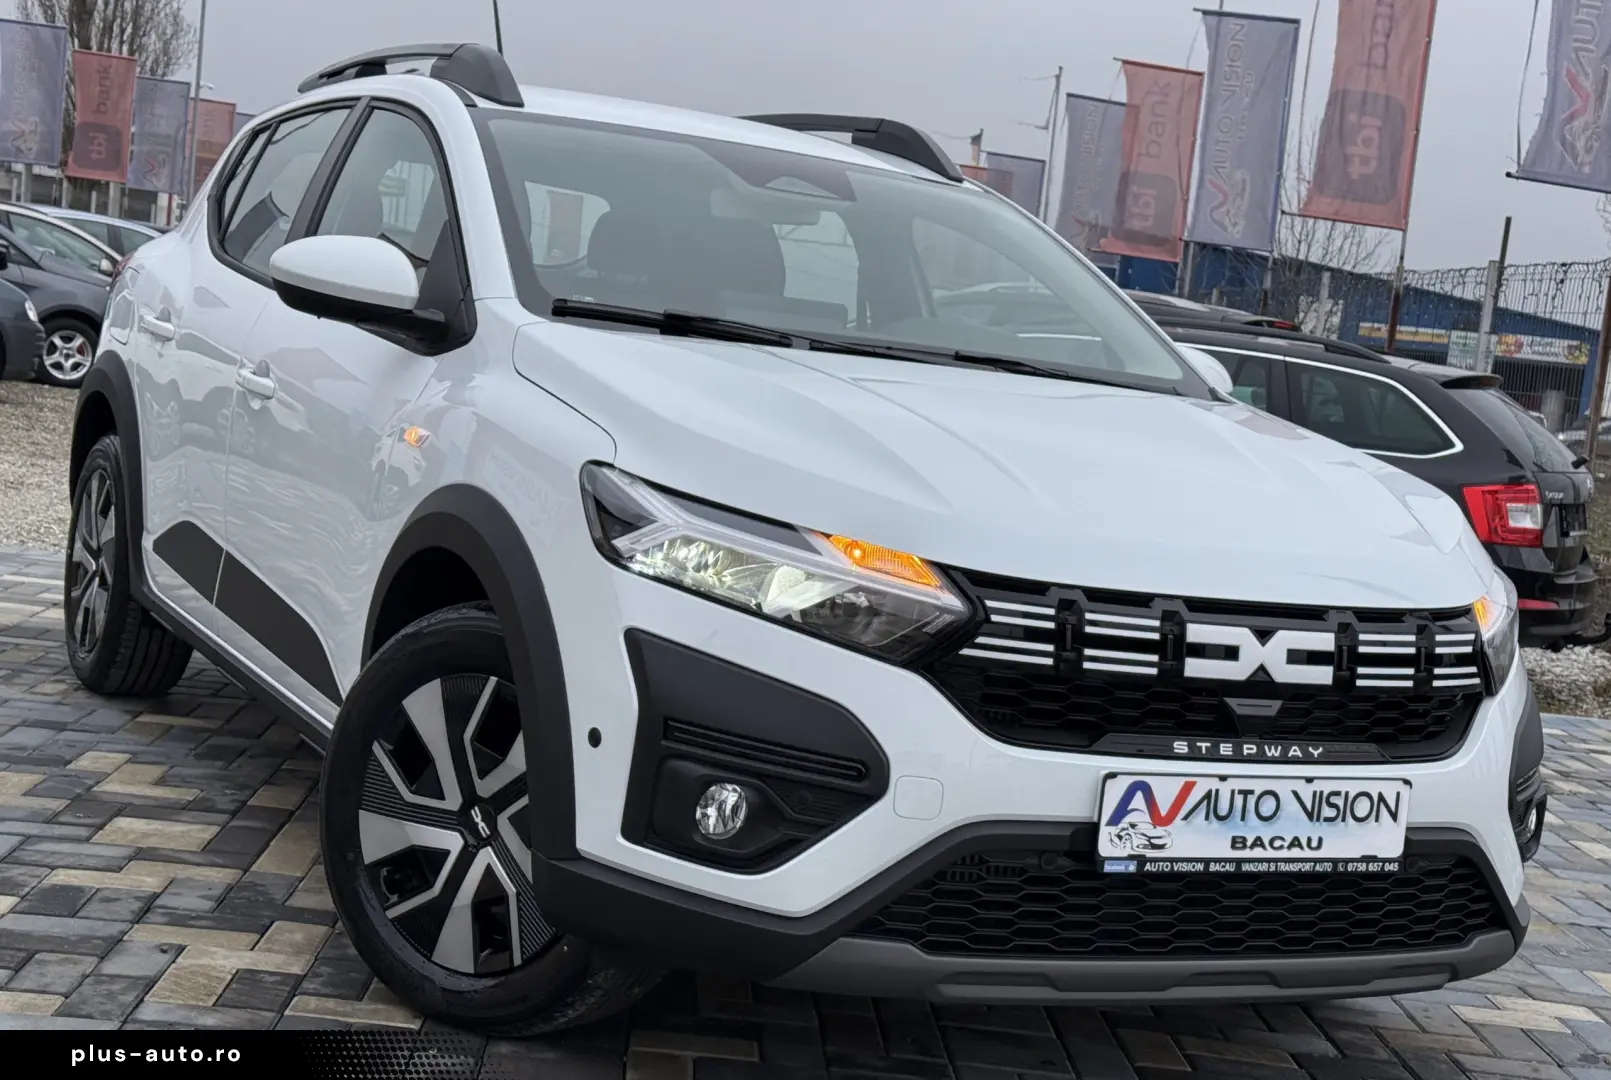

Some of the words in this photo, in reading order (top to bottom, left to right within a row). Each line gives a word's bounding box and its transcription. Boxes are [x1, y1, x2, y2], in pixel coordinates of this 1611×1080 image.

[1361, 0, 1394, 70] ba
[92, 61, 112, 115] bank
[1221, 21, 1246, 107] VISION
[1138, 80, 1171, 159] bank
[88, 132, 108, 160] tbi
[1213, 115, 1234, 185] AUTO
[1345, 115, 1383, 180] tbi
[1131, 187, 1157, 231] tbi
[1173, 741, 1323, 758] STEPWAY
[1180, 788, 1281, 823] AUTO
[1291, 789, 1401, 824] VISION
[1144, 862, 1171, 872] AUTO
[1173, 862, 1204, 872] VISION
[1209, 862, 1236, 872] BACAU
[1241, 862, 1269, 872] VANZARI
[1277, 862, 1314, 872] TRANSPORT
[1314, 862, 1333, 872] AUTO
[1347, 862, 1366, 872] 0758
[1368, 862, 1383, 872] 657
[1384, 862, 1399, 872] 045
[1230, 835, 1324, 852] BACAU
